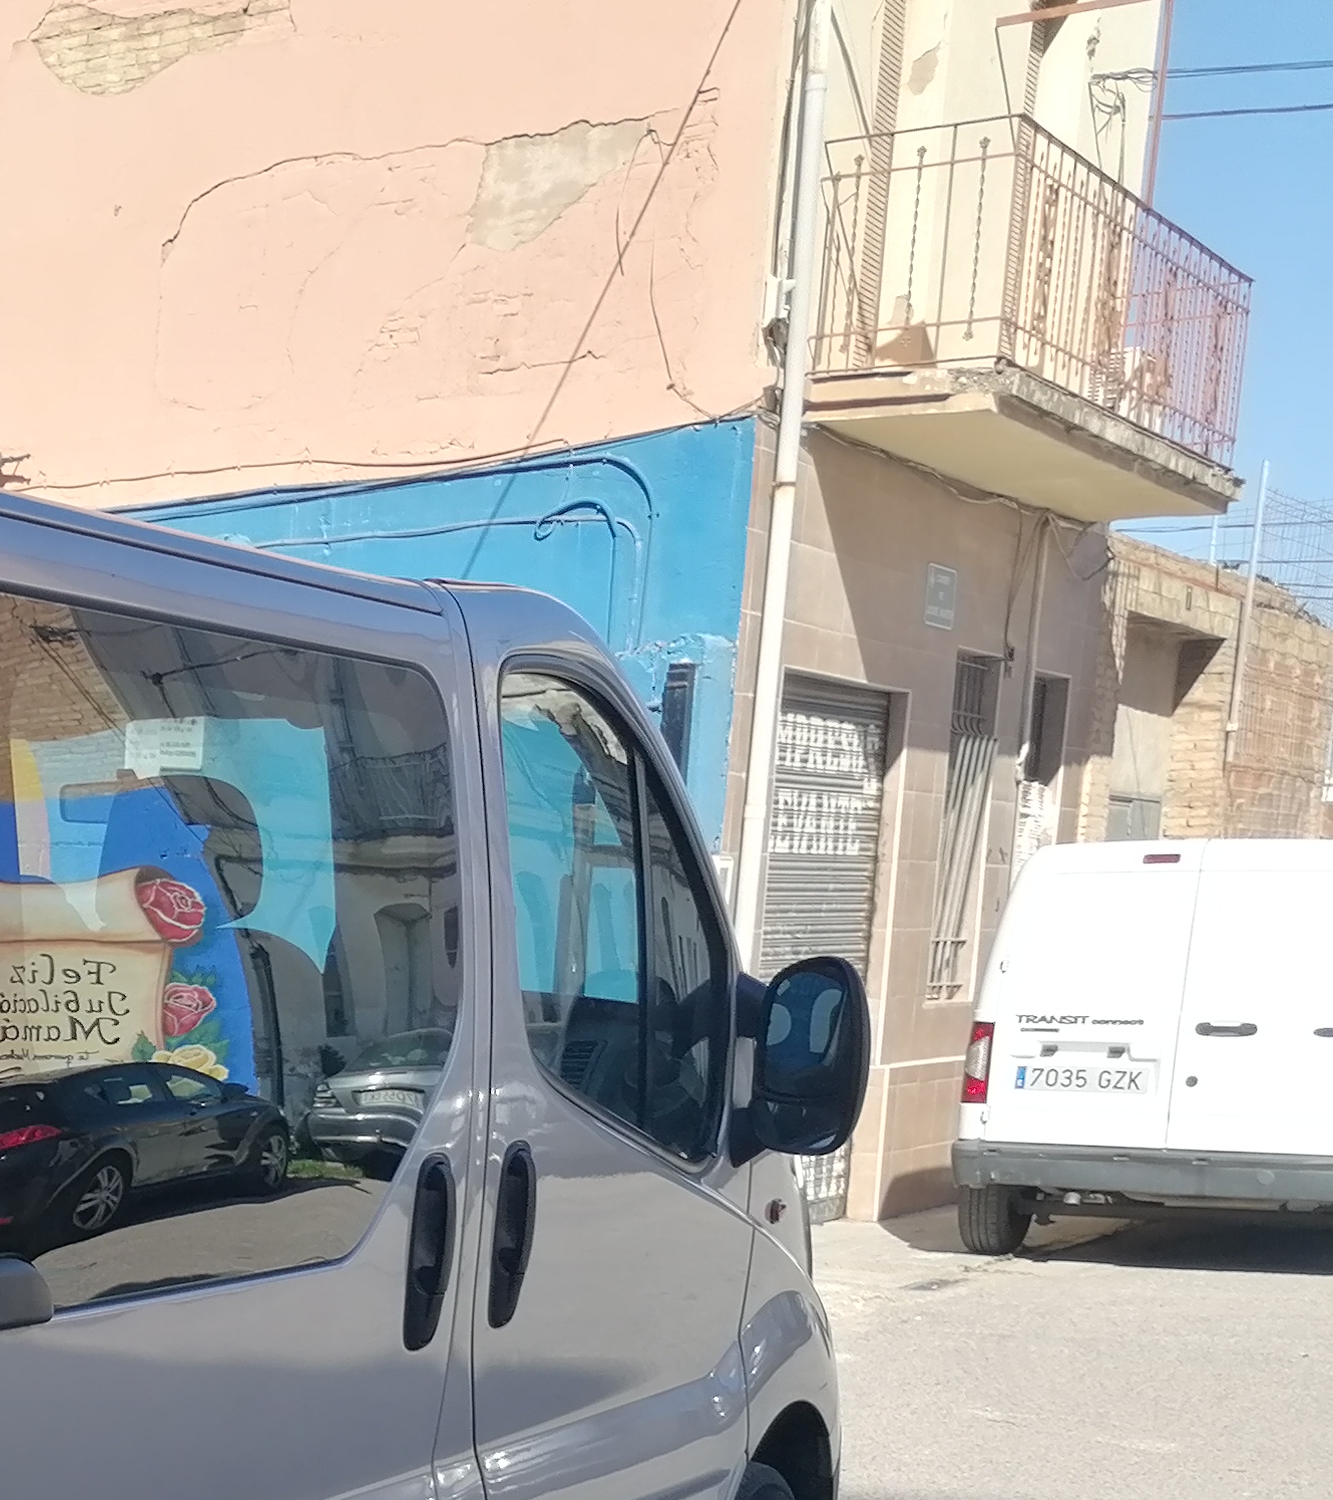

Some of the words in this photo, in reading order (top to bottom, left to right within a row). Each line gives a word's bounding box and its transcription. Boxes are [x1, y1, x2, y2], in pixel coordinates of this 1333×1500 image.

[1016, 1014, 1090, 1024] TRANSIT
[1030, 1067, 1088, 1088] 7035
[1098, 1070, 1143, 1090] GZK
